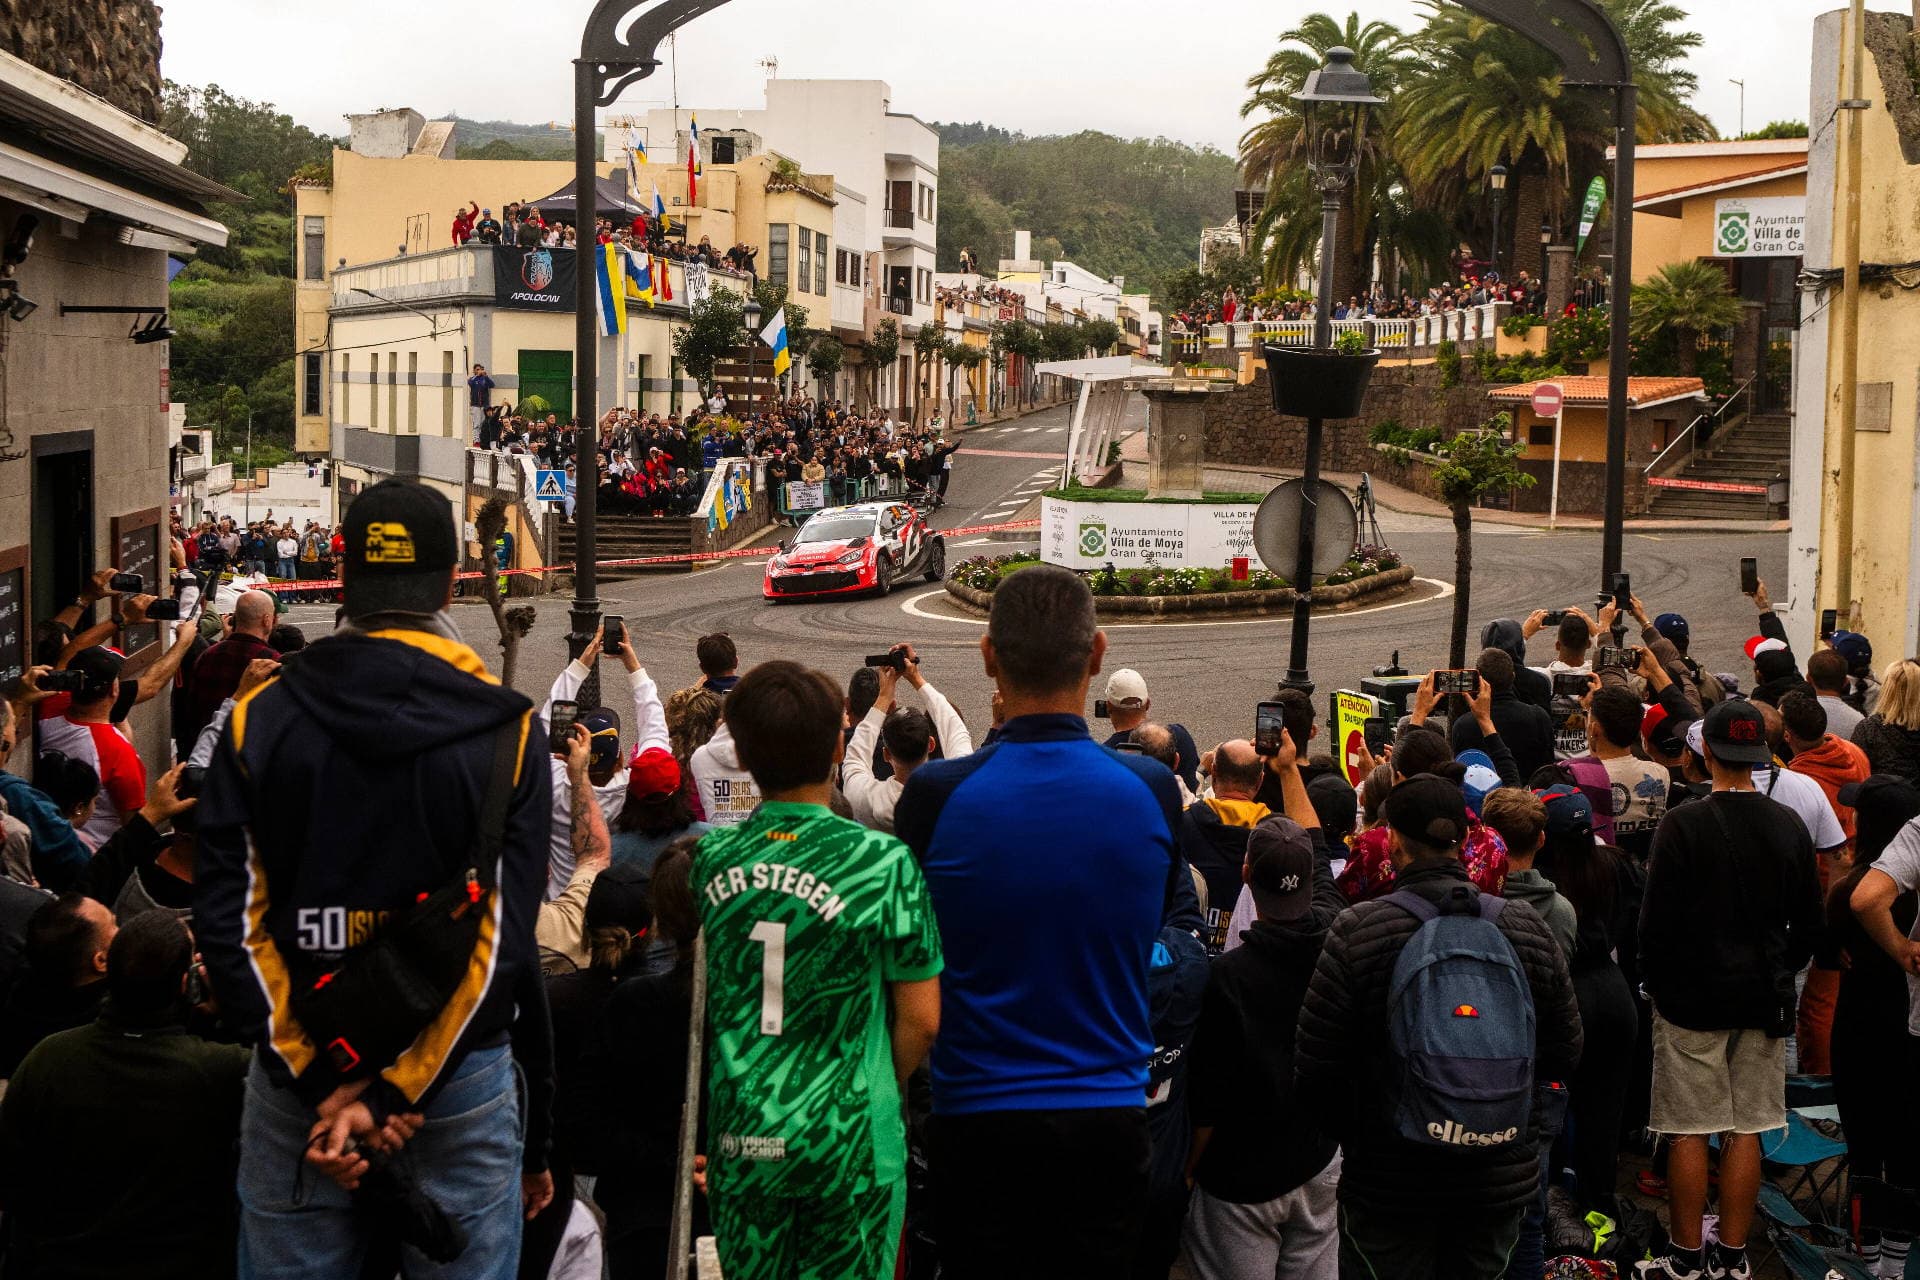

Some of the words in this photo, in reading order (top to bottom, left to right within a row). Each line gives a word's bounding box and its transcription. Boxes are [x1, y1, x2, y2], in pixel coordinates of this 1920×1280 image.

[1754, 227, 1781, 239] Villa
[1785, 227, 1800, 239] de
[1753, 241, 1783, 252] Gran
[510, 292, 561, 303] APOLOCAN
[1111, 527, 1184, 538] Ayuntamiento
[1110, 537, 1135, 548] Villa
[1138, 537, 1151, 548] de
[1155, 538, 1184, 551] Moya
[1110, 548, 1136, 558] Gran
[1140, 549, 1184, 559] Canaria
[713, 779, 731, 797] 50
[704, 865, 748, 907] TER
[752, 862, 846, 922] STEGEN
[297, 906, 346, 951] 50
[748, 920, 787, 1036] 1
[1427, 1119, 1518, 1147] ellesse
